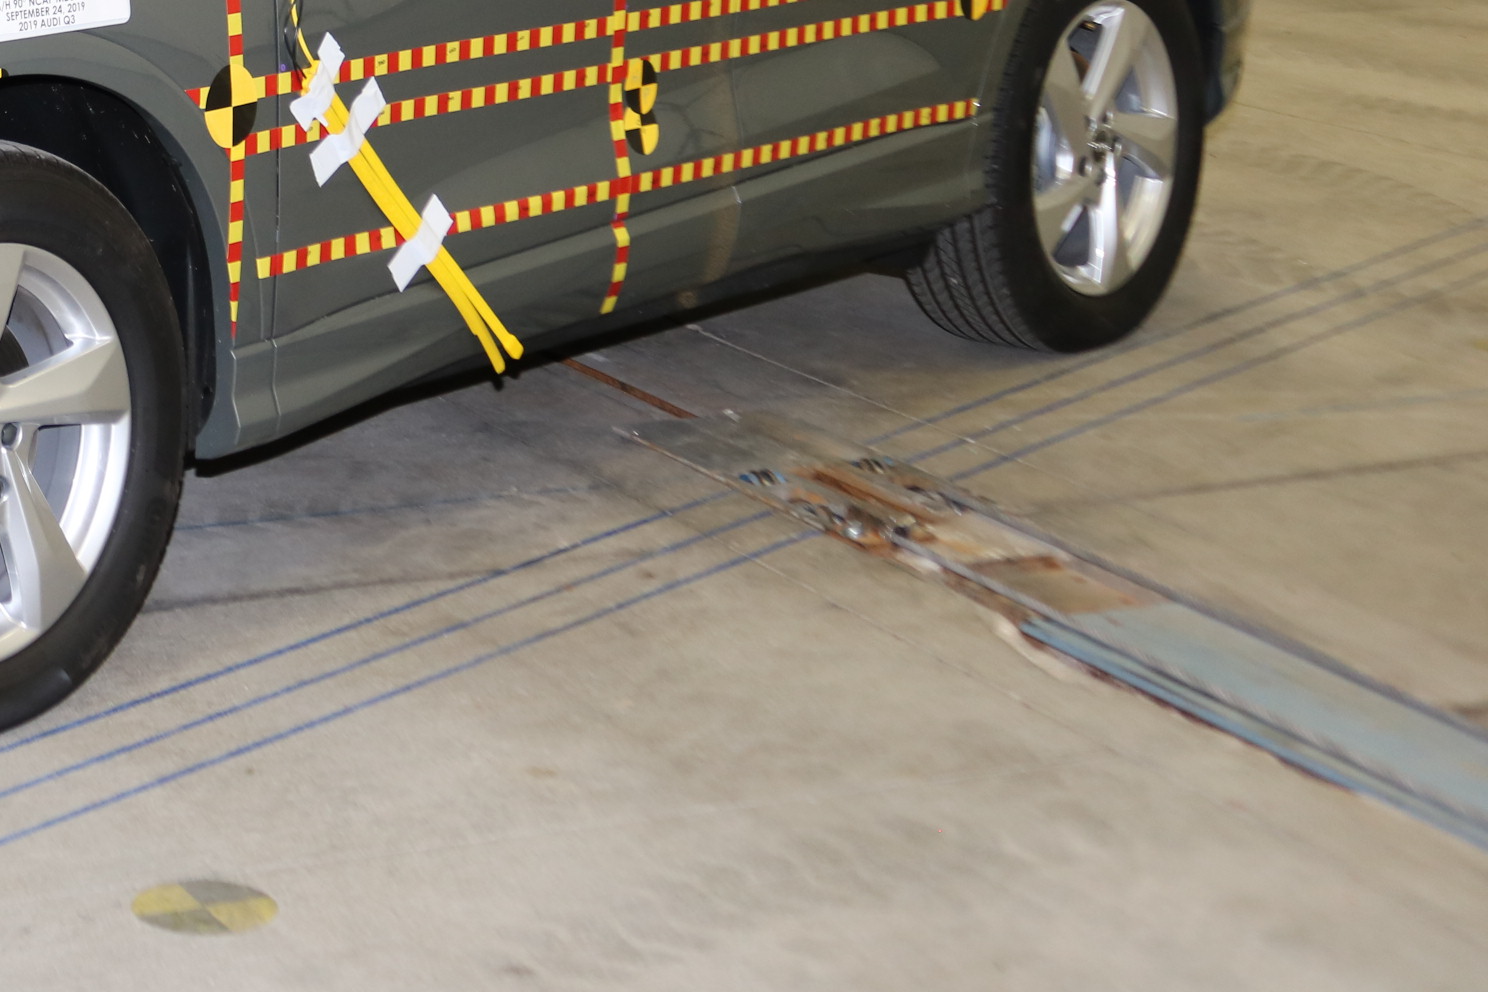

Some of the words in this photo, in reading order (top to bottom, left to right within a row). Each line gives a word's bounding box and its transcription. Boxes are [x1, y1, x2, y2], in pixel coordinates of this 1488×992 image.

[5, 6, 50, 22] SEPTEMBER
[52, 4, 65, 16] 24,
[67, 1, 86, 14] 2019
[18, 19, 38, 32] 2019
[40, 16, 61, 28] AUDI
[63, 14, 76, 26] Q3
